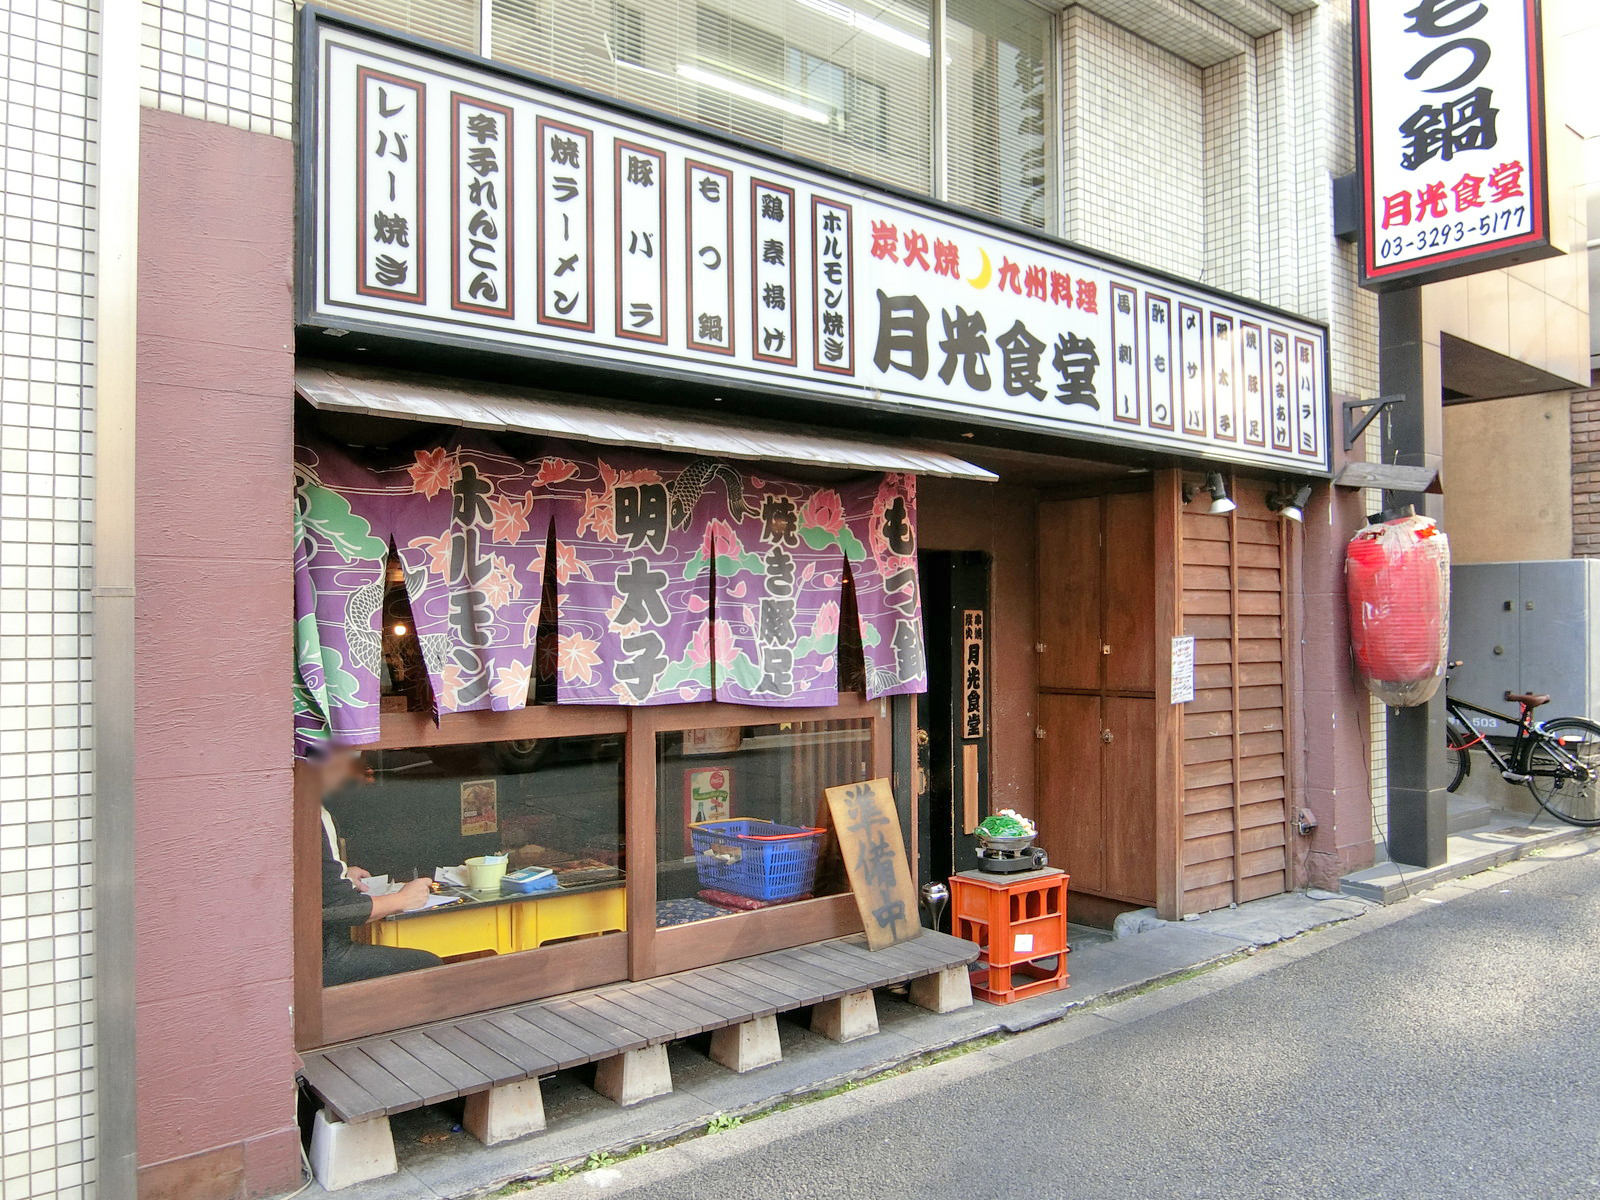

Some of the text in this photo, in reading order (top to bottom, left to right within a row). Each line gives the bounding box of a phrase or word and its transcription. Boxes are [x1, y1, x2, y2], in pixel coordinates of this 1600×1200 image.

[1399, 0, 1499, 171] もつ鍋
[374, 87, 409, 286] レバー焼き
[466, 113, 499, 302] 辛子れんこん
[550, 135, 580, 314] 焼ラーメン
[627, 156, 654, 328] 豚バラ
[698, 177, 723, 342] もつ鍋
[1381, 160, 1525, 230] 月光食堂
[1381, 206, 1525, 258] 03-3293-5177
[762, 194, 786, 352] 鶏素揚げ
[822, 211, 844, 362] ホルモン焼き
[871, 220, 1099, 315] 炭火焼 九州料理
[873, 289, 1100, 411] 月光食堂
[1151, 304, 1167, 421] 酢もつ
[1216, 322, 1230, 432] 明太子
[1246, 331, 1259, 438] 焼豚足
[1300, 347, 1312, 448] 豚ハラミ
[450, 462, 495, 705] ホルモン
[613, 483, 671, 702] 明太子
[752, 494, 799, 697] 焼き豚足
[967, 643, 981, 736] 月光食堂
[1472, 717, 1497, 728] 503
[843, 784, 906, 943] 準備中
